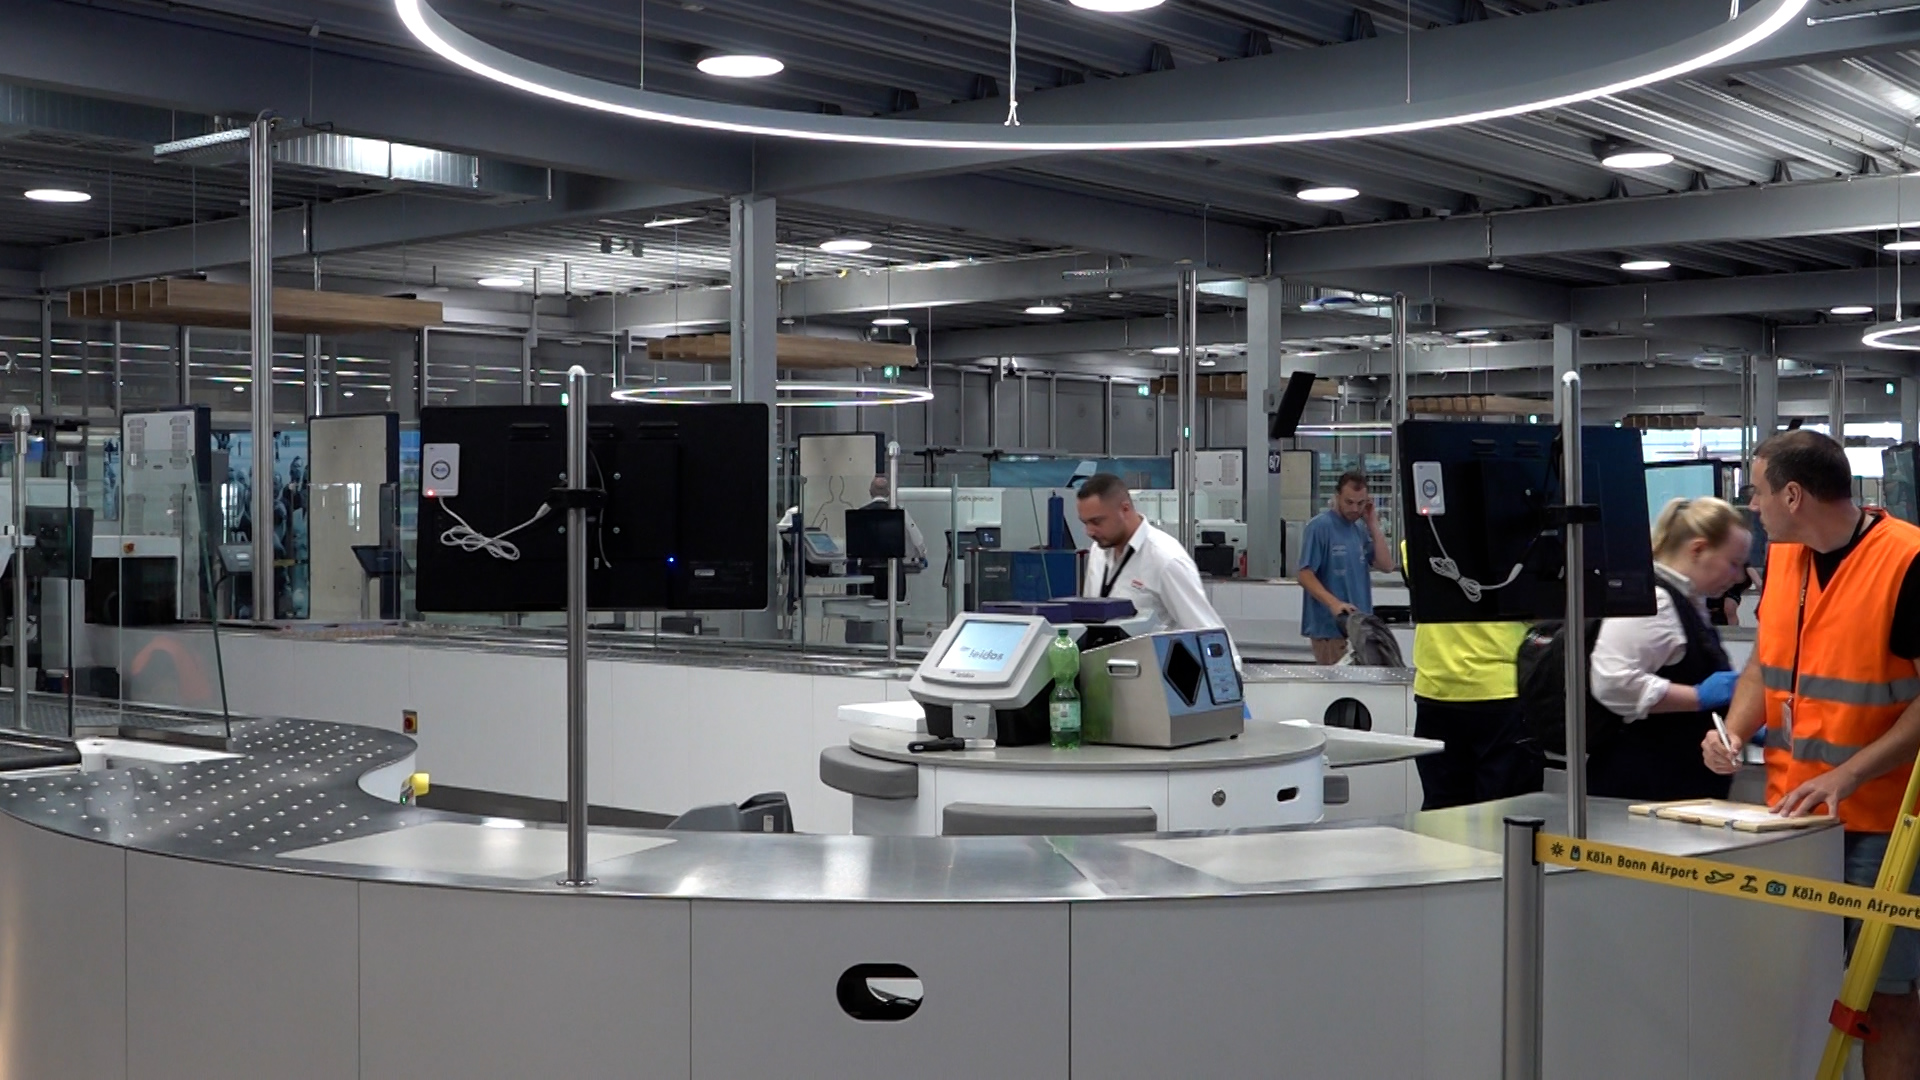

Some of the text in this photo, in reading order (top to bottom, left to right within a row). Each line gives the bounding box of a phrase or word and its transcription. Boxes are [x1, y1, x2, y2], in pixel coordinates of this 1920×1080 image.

[968, 650, 1004, 661] leidos
[1586, 850, 1698, 880] Köln Bonn Airport
[1792, 886, 1920, 918] Köln Bonn Airport
